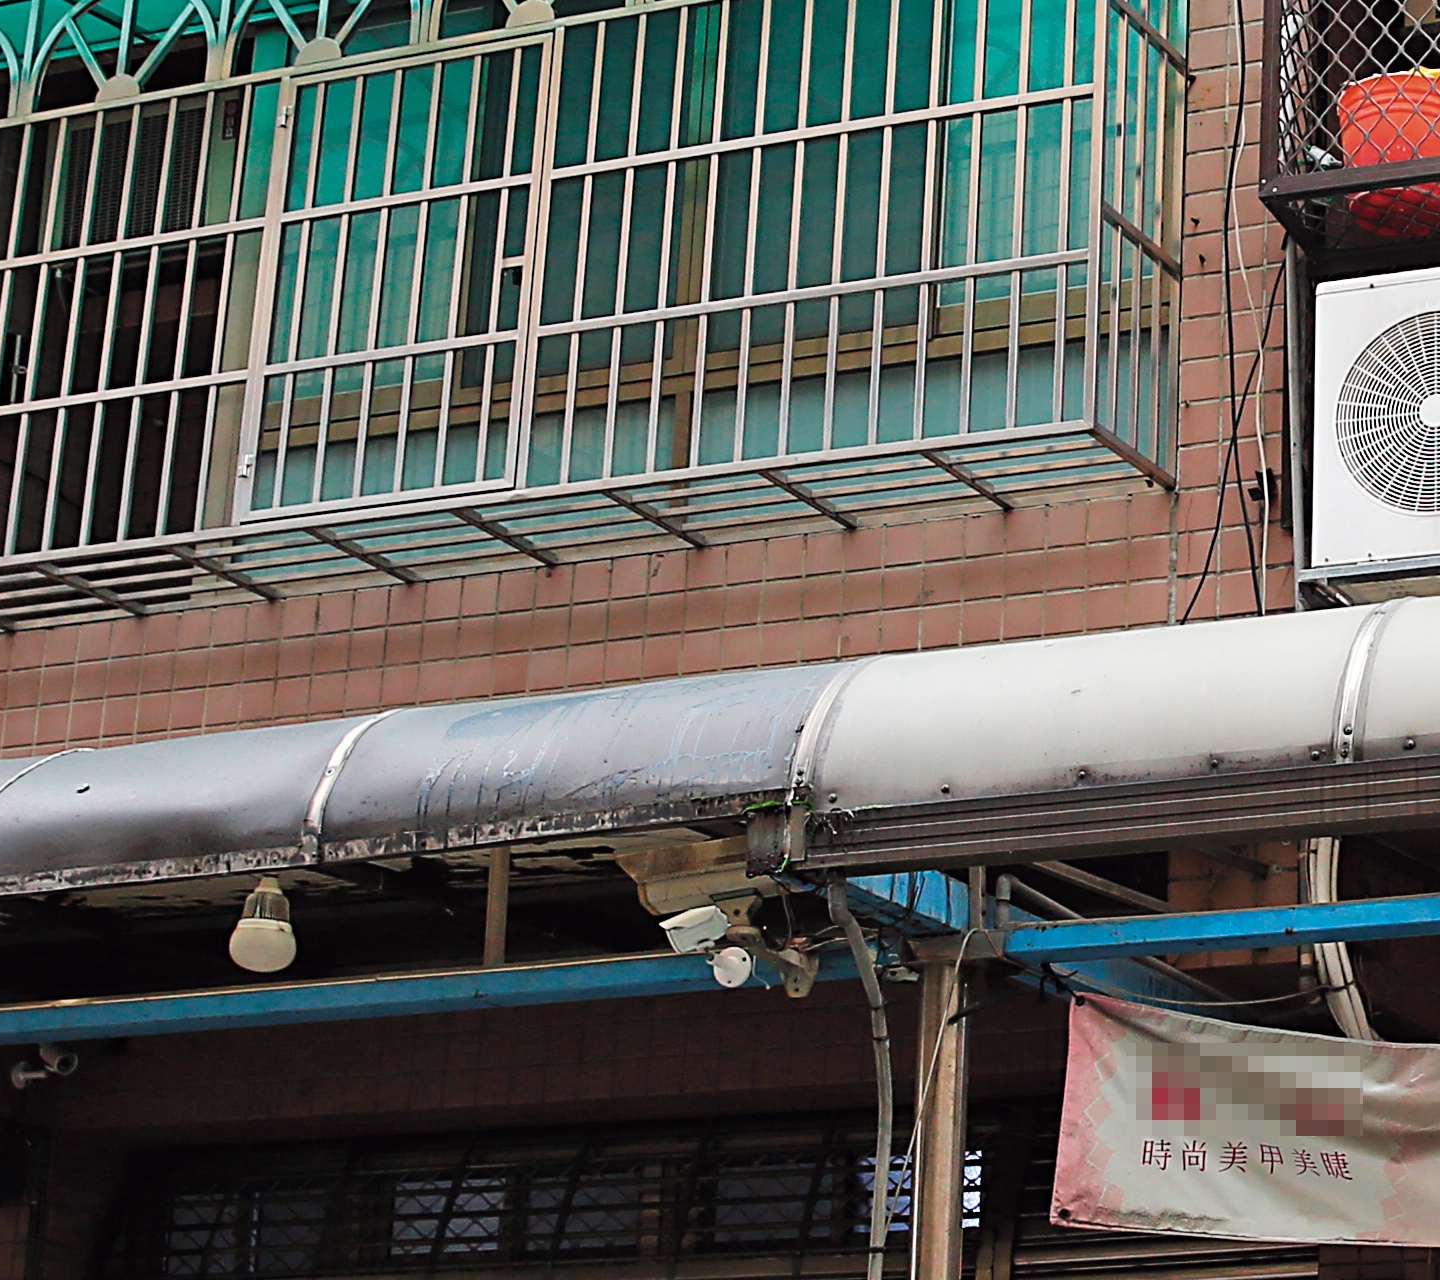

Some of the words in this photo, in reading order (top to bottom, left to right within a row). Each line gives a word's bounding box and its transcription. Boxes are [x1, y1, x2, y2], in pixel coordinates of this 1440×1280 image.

[1141, 1138, 1353, 1180] 時尚美甲美睫
